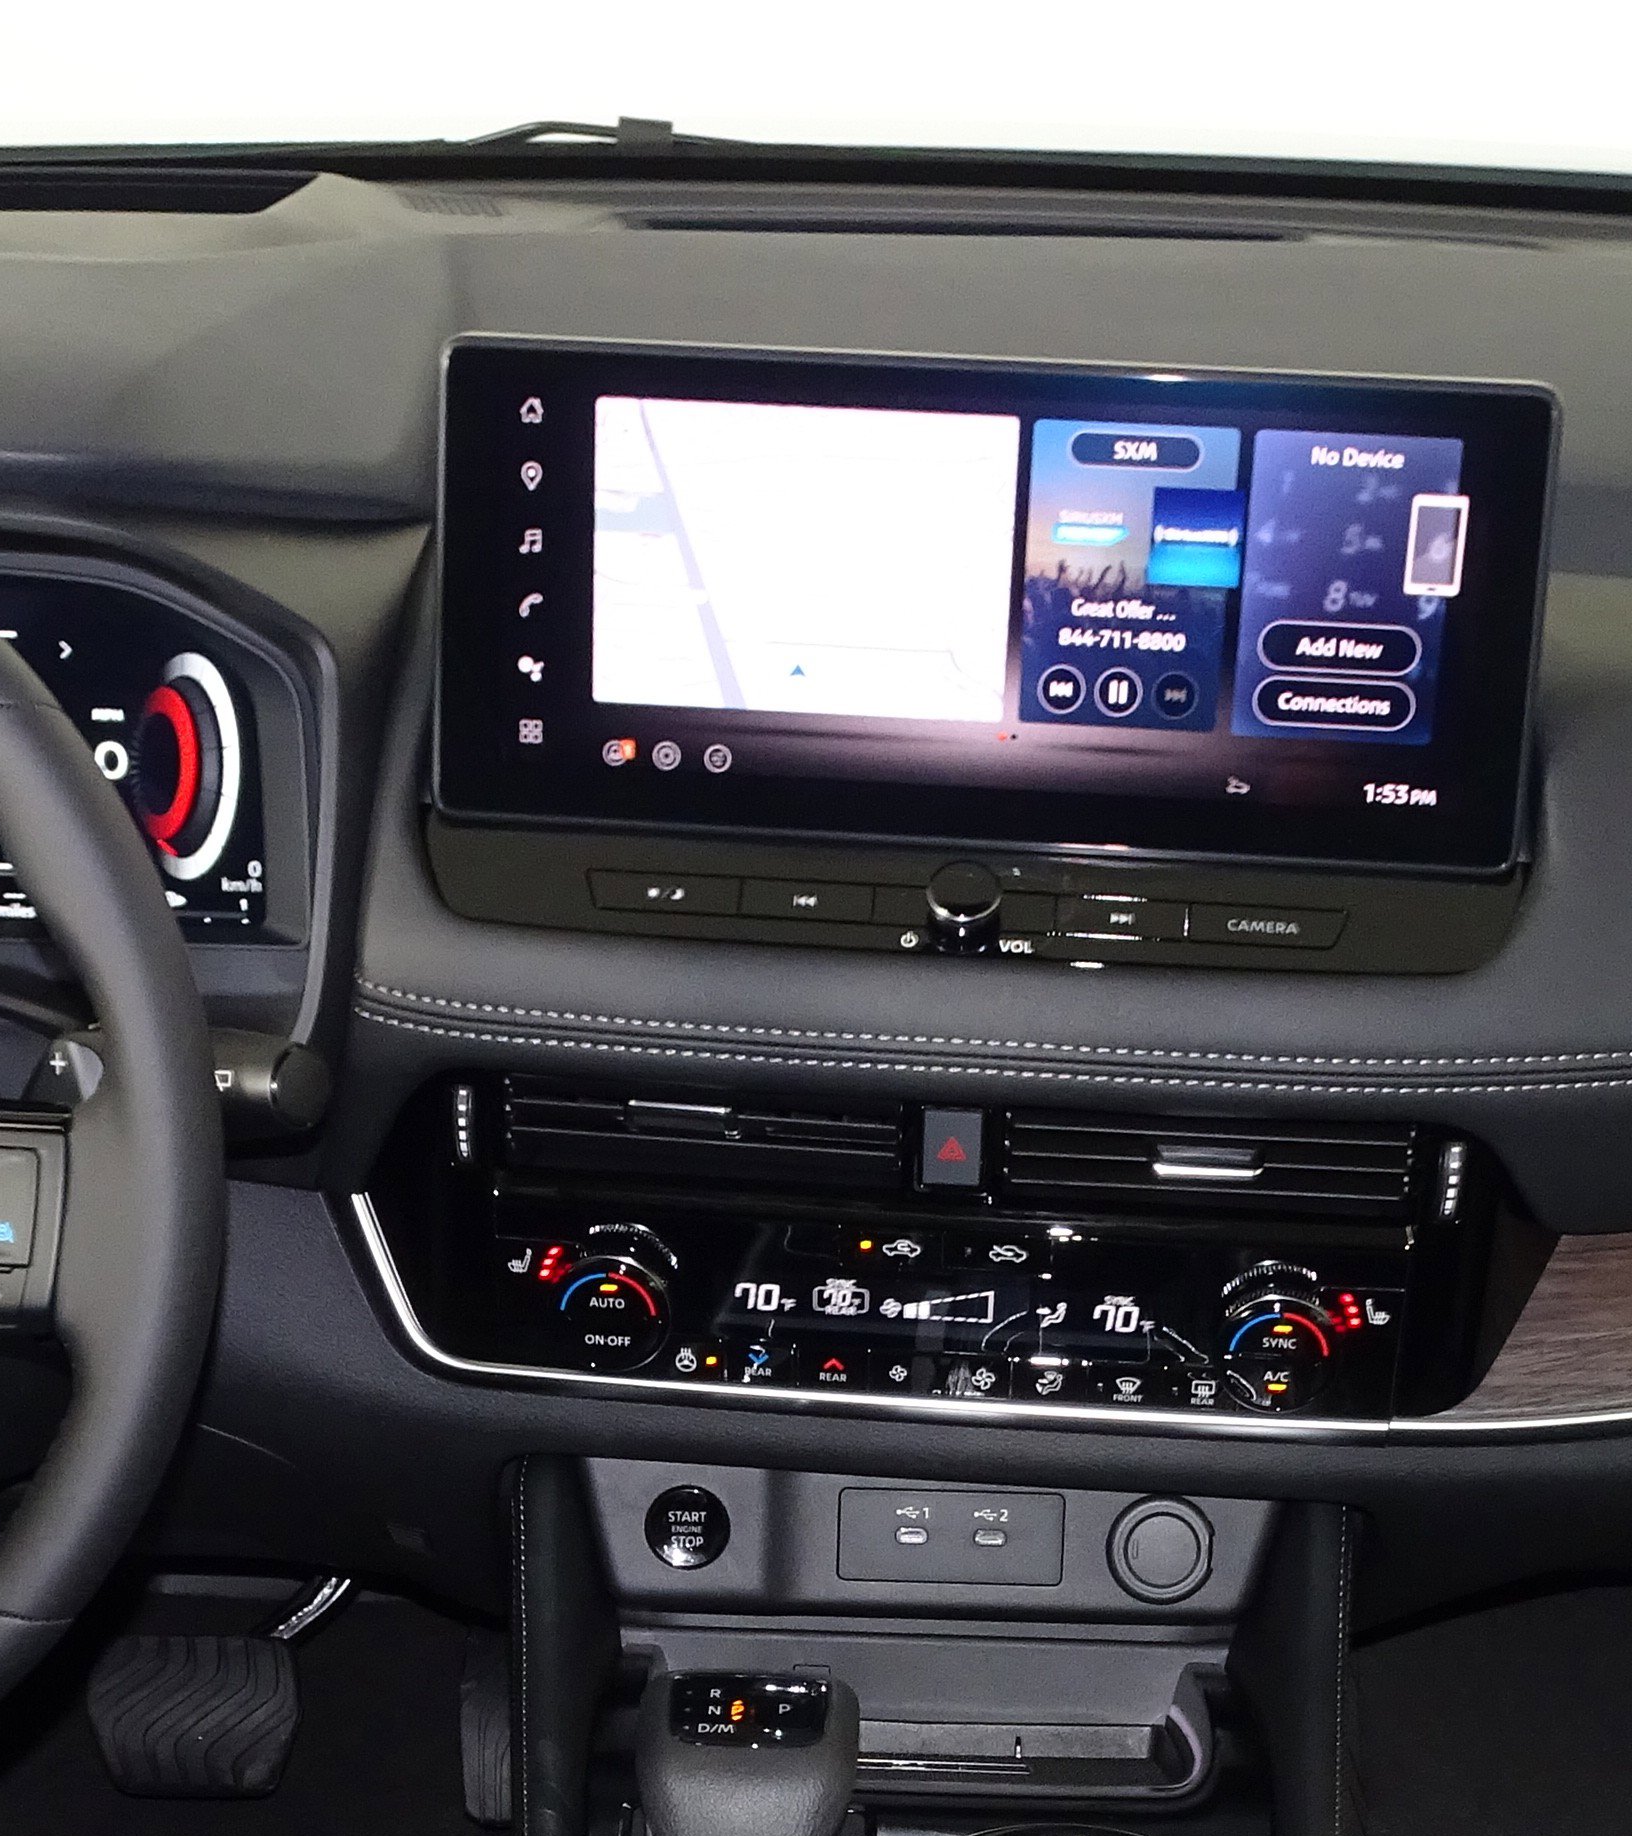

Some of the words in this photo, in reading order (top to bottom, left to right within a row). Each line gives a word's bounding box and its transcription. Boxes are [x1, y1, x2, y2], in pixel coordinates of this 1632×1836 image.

[1113, 440, 1158, 462] SXM
[1310, 446, 1340, 467] No
[1342, 447, 1405, 470] Device
[1323, 580, 1349, 613] 8
[1070, 599, 1115, 619] Great
[1115, 600, 1156, 619] Offer
[1296, 637, 1336, 658] Add
[1338, 639, 1384, 661] New
[1277, 692, 1391, 717] Connections
[247, 860, 262, 877] 0
[1226, 918, 1300, 936] CAMERA
[999, 939, 1035, 955] VOL
[589, 1298, 625, 1309] AUTO
[1262, 1337, 1297, 1349] SYNC
[819, 1372, 847, 1382] REAR
[1263, 1370, 1290, 1382] A/C
[1112, 1394, 1143, 1402] FRONT
[1190, 1397, 1215, 1406] REAR
[668, 1510, 706, 1522] START
[922, 1507, 929, 1519] 1
[999, 1509, 1009, 1522] 2
[671, 1525, 702, 1533] ENGINE
[671, 1535, 704, 1548] STOP
[710, 1689, 721, 1698] R
[708, 1705, 721, 1715] N
[779, 1704, 791, 1714] P
[697, 1723, 735, 1734] D/M
